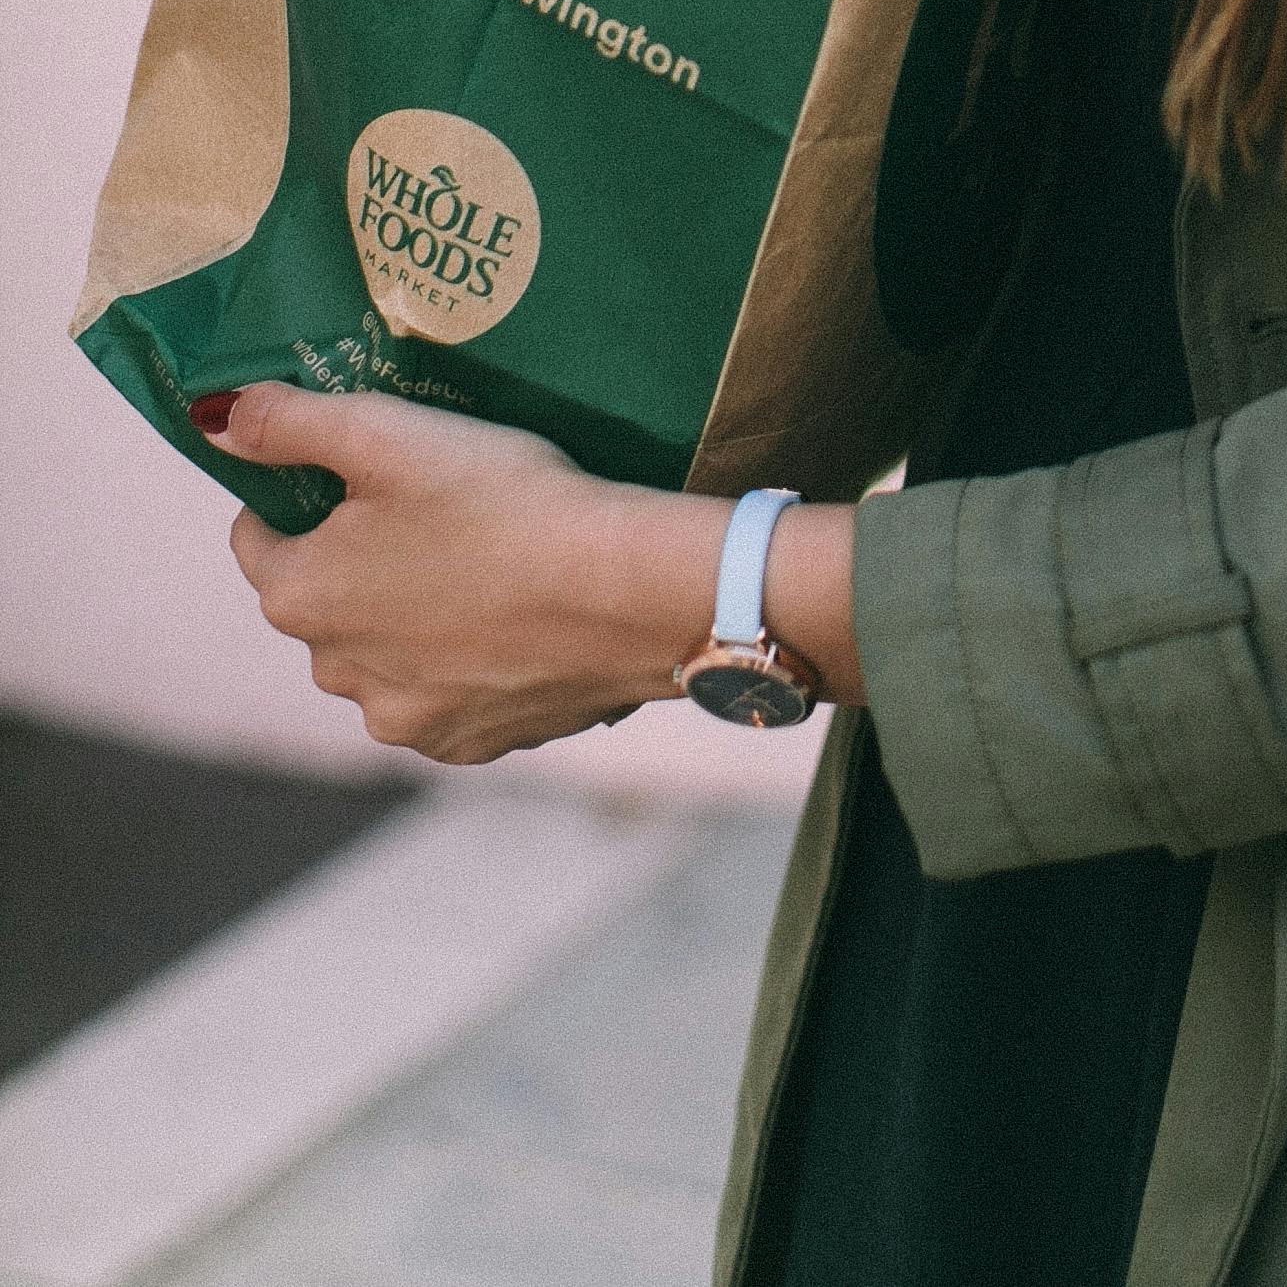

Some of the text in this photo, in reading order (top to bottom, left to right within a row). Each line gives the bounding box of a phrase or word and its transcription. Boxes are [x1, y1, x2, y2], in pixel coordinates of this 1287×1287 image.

[359, 193, 500, 298] FOODS
[367, 146, 522, 258] WHOLE
[364, 248, 461, 312] MARKET
